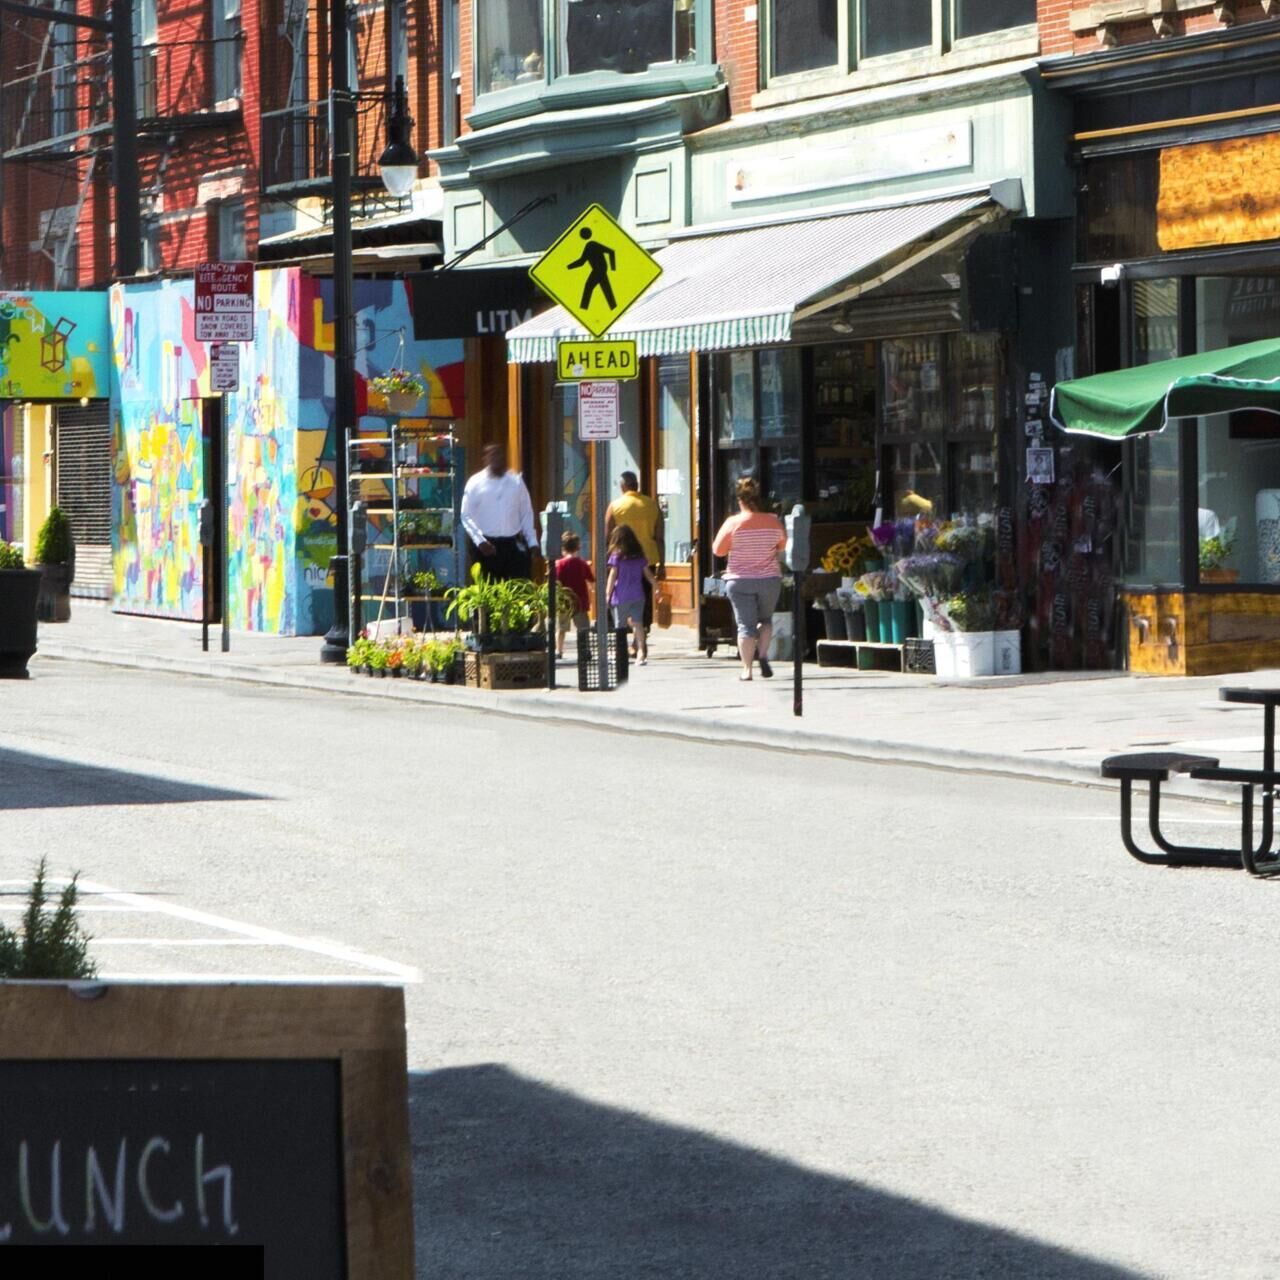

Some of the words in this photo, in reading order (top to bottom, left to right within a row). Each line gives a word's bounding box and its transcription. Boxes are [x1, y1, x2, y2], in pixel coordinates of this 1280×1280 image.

[210, 283, 238, 292] ROUTE
[197, 295, 212, 311] NO
[215, 298, 252, 308] PARKING
[566, 349, 631, 370] AHEAD
[581, 384, 593, 397] NO
